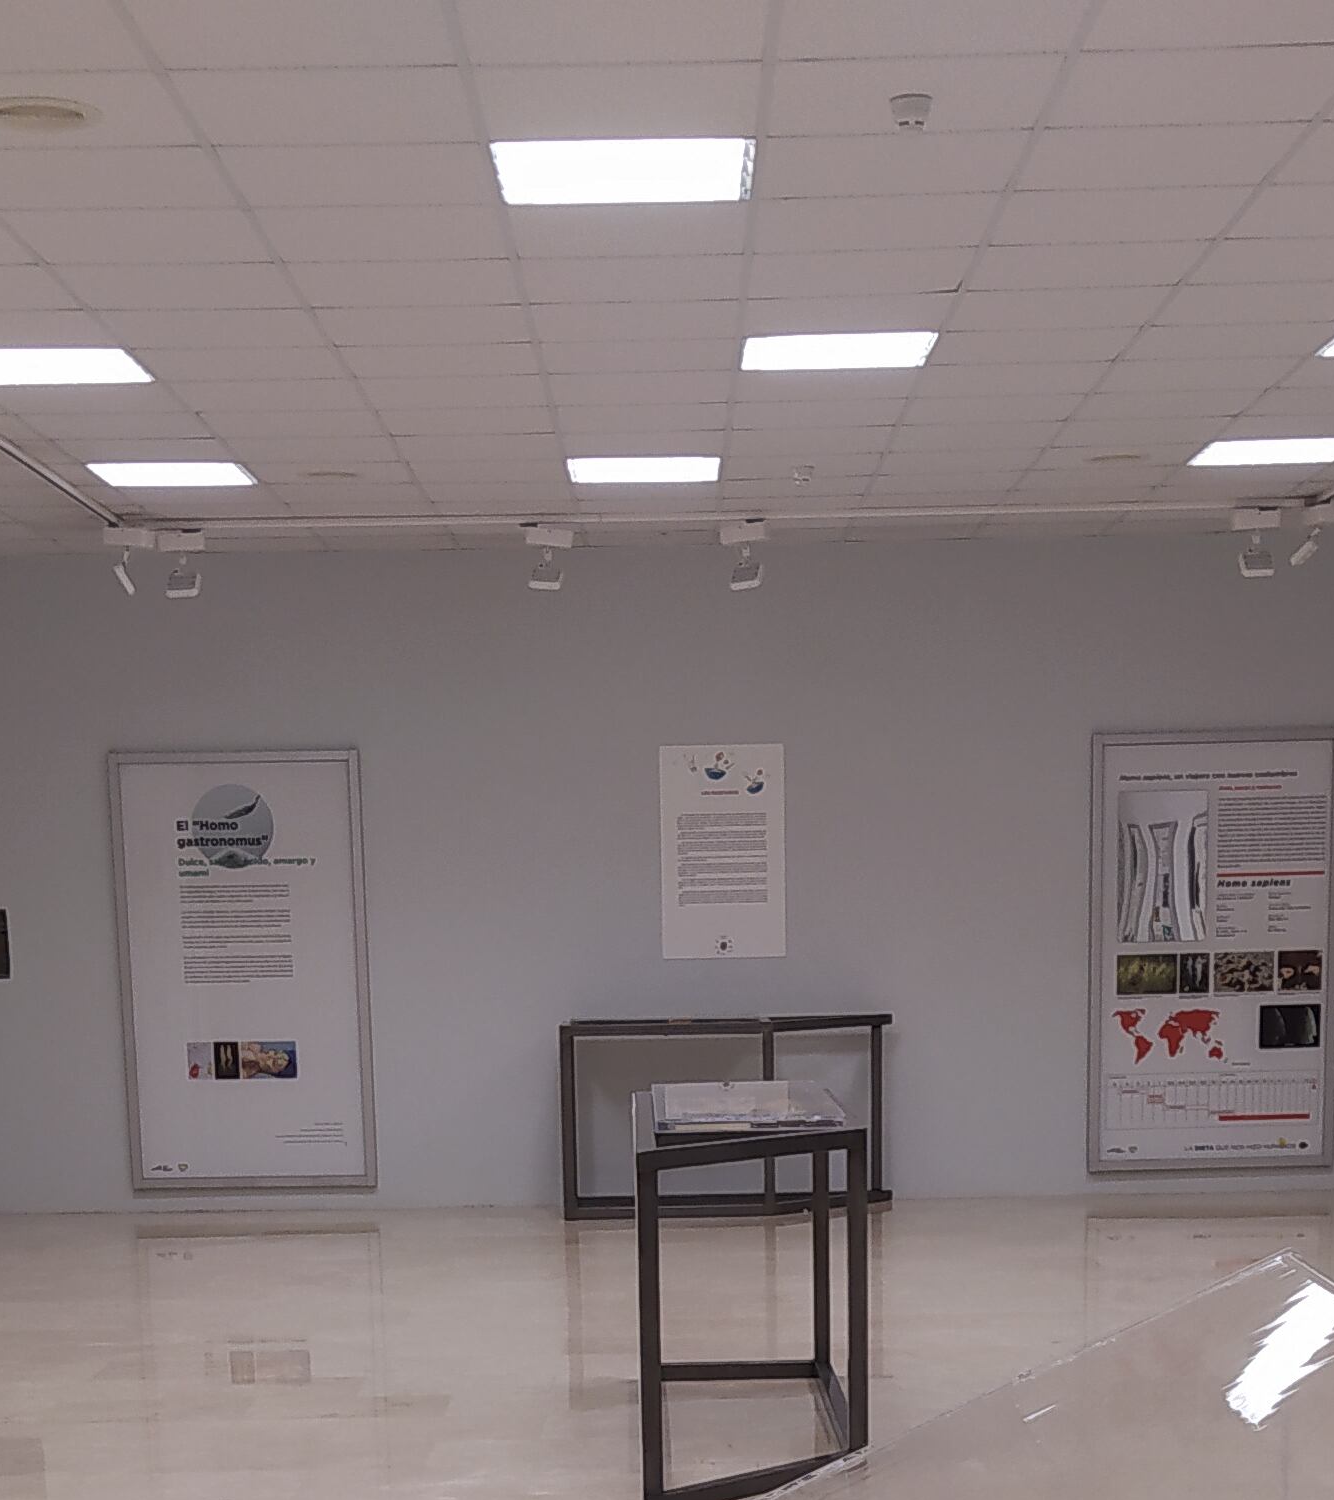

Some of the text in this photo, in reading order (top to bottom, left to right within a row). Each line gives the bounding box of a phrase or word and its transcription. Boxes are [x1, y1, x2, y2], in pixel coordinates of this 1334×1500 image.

[176, 820, 189, 831] El
[177, 835, 268, 849] gastronomus"
[1217, 879, 1291, 888] Homo sapiens
